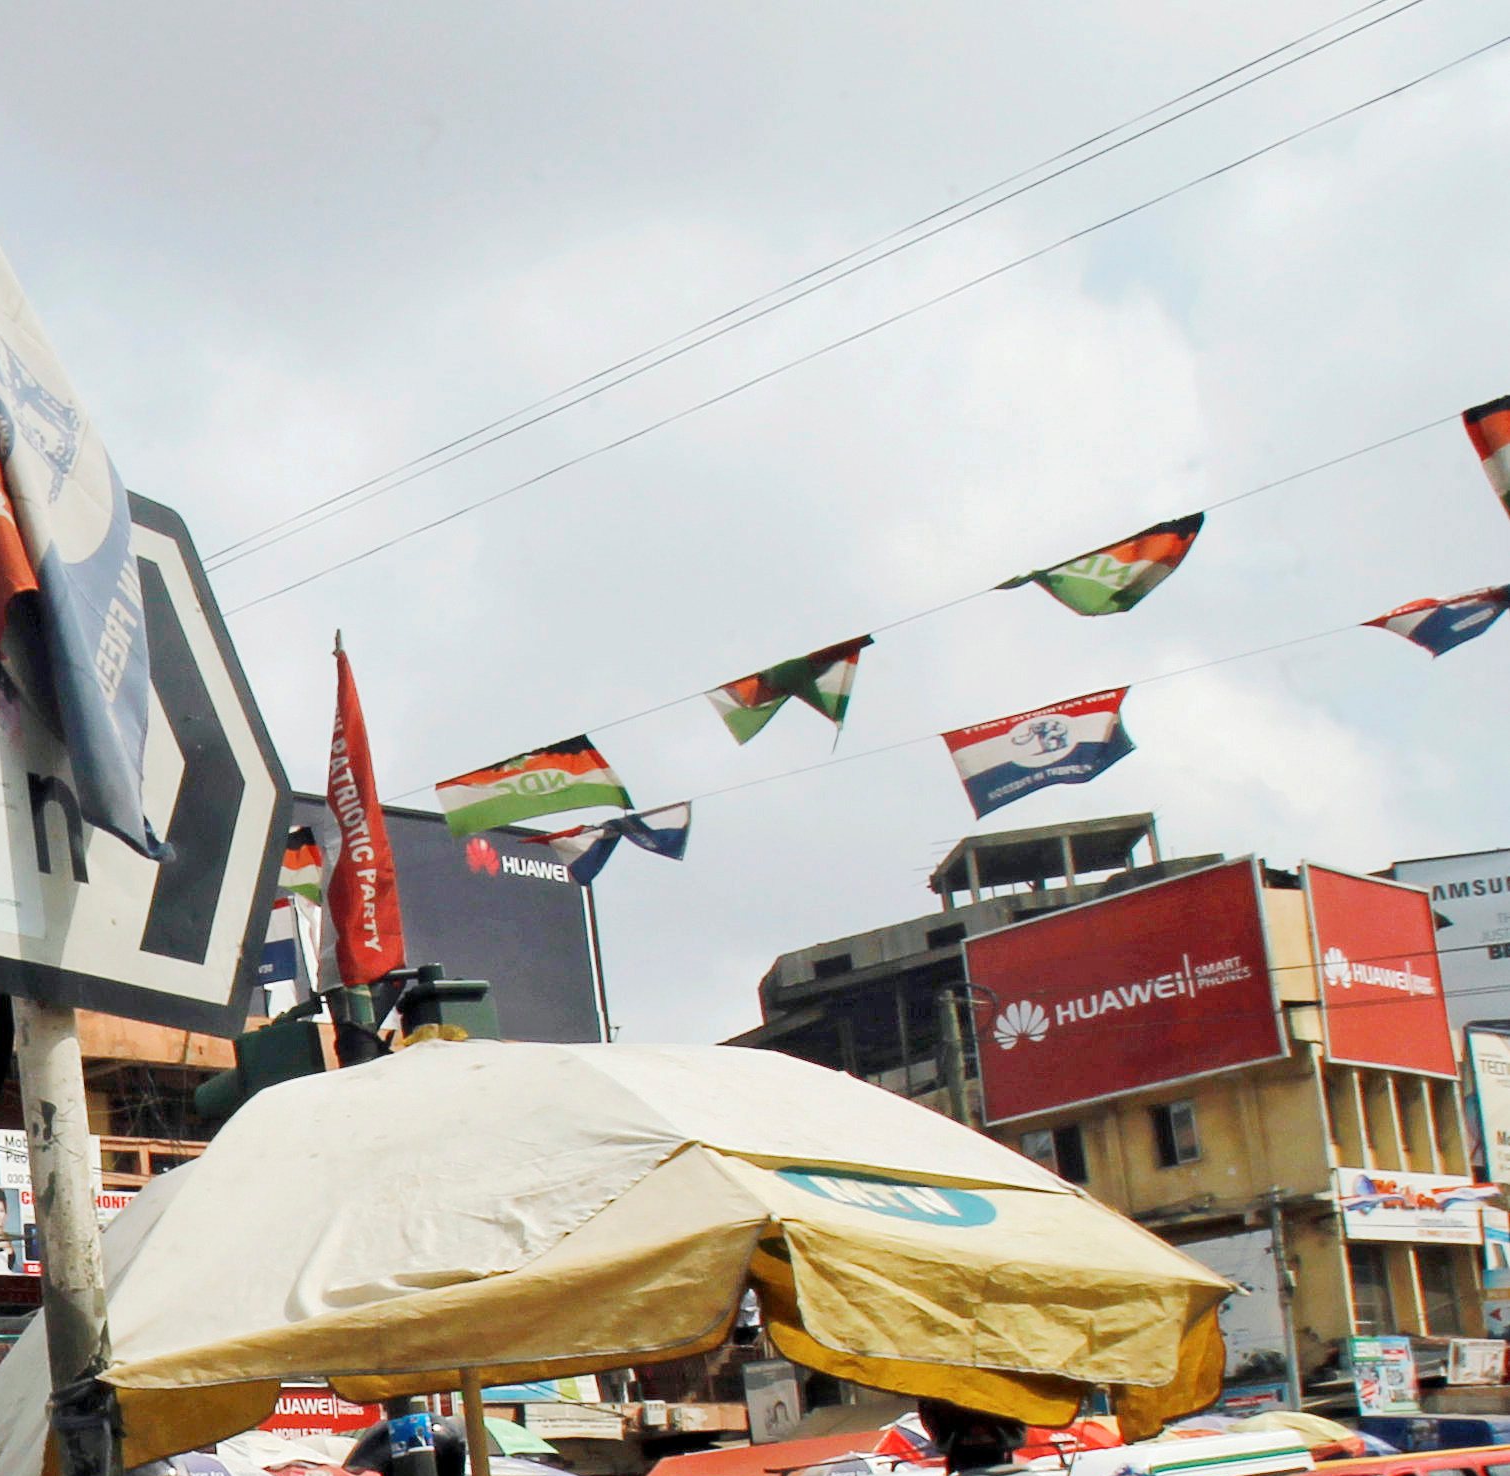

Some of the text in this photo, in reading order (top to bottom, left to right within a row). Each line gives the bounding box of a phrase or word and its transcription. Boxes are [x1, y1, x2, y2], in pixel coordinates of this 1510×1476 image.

[328, 736, 383, 954] PATRIOTIC PARTY
[500, 855, 570, 884] HUAWEI
[1055, 955, 1242, 1027] HUAWEI SMART
[1197, 965, 1252, 990] PHONES
[1351, 962, 1410, 992] HUAWEI
